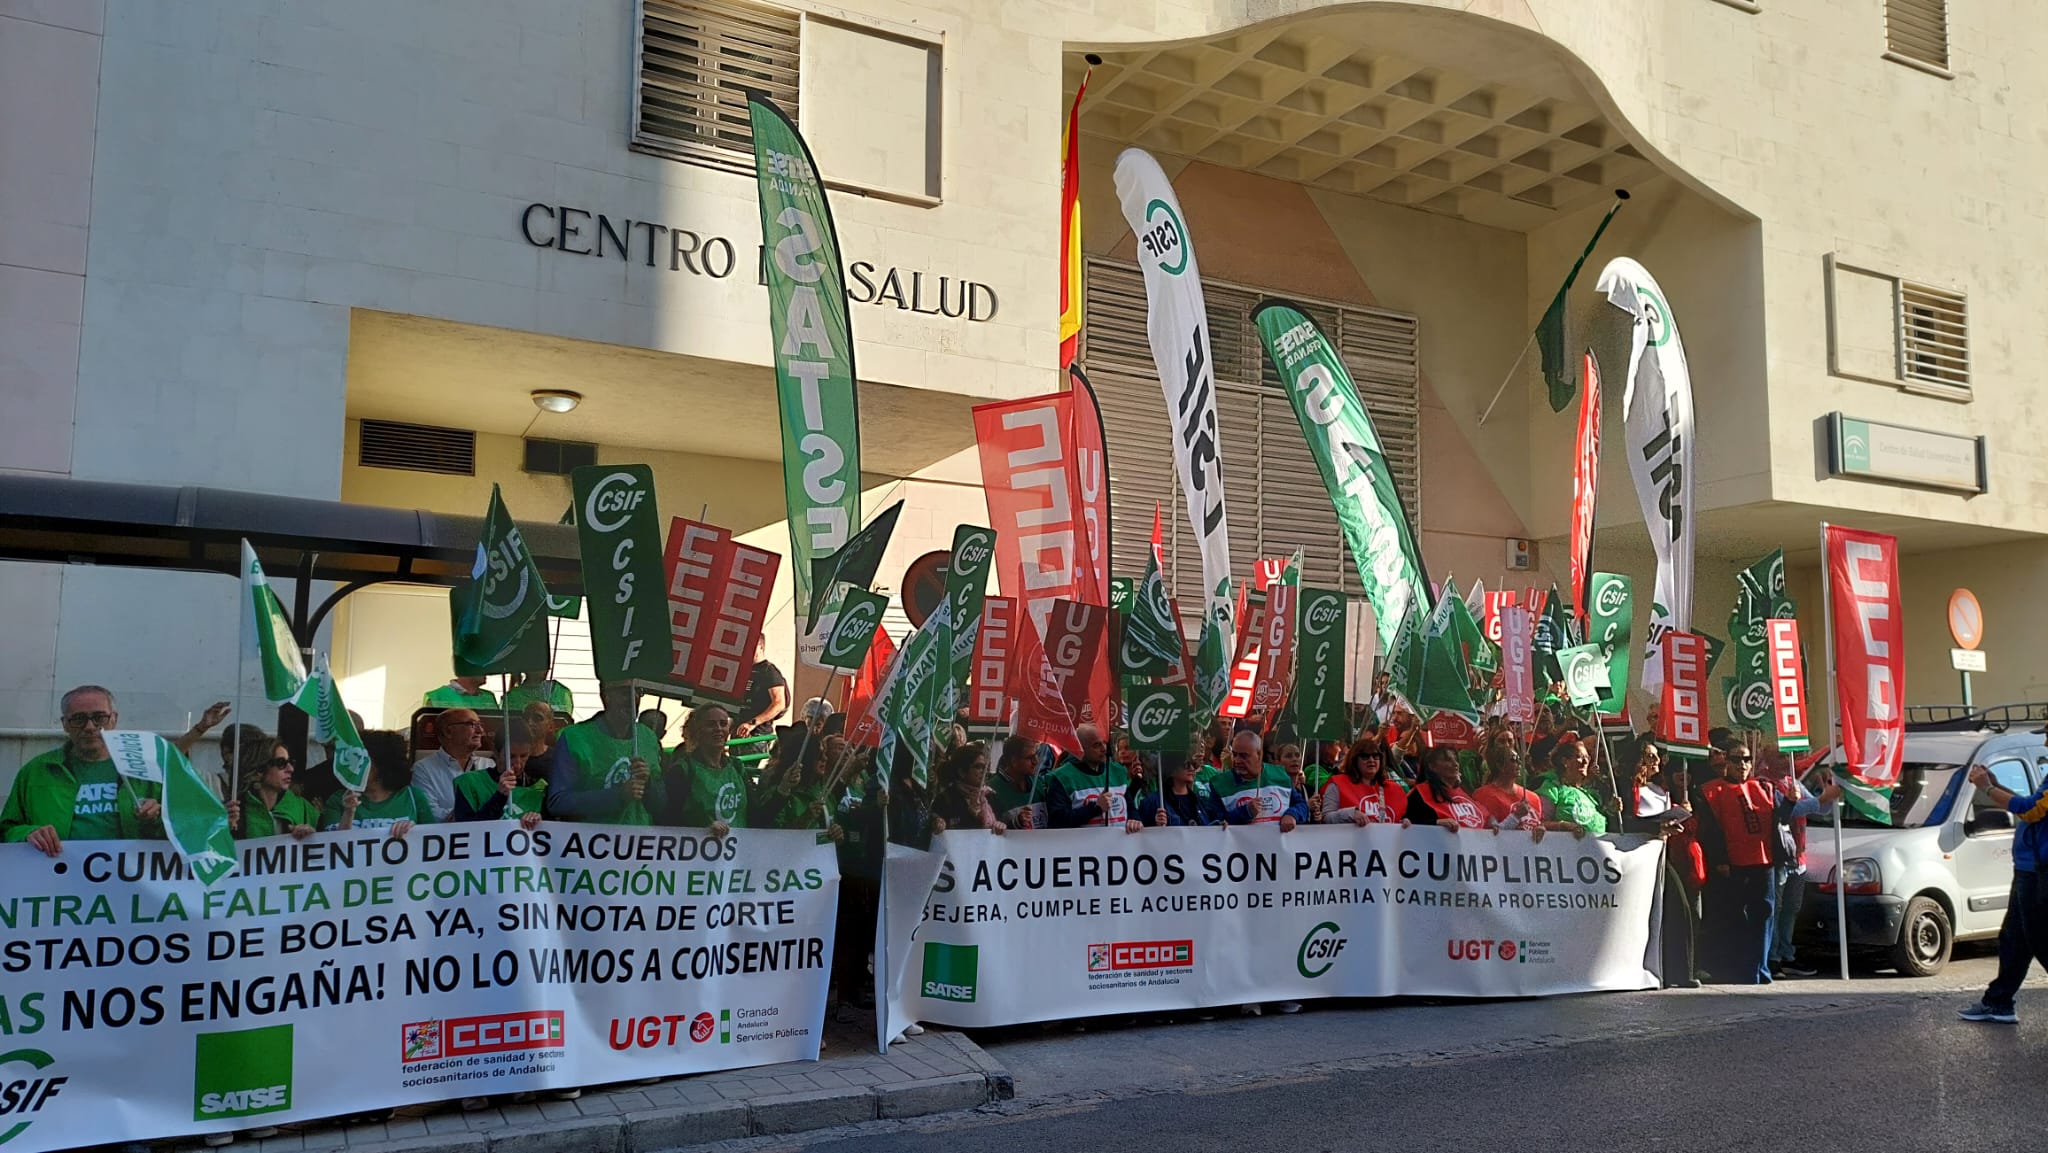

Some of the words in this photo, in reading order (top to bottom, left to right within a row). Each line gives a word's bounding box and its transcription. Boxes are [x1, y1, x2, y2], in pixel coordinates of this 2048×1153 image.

[522, 203, 736, 279] CENTRO
[846, 261, 999, 323] SALUD
[612, 537, 645, 672] CSIF
[699, 545, 769, 693] CCOO
[1268, 586, 1288, 679] UGT
[1510, 609, 1525, 694] UGT
[978, 599, 1009, 717] CCOO
[1773, 623, 1802, 732] CCOO
[1311, 640, 1328, 734] CSIF
[1672, 636, 1700, 741] CCOO
[83, 837, 408, 884] CUMIMIENTO
[422, 832, 470, 863] DE
[484, 829, 552, 859] LOS
[560, 830, 738, 863] ACUERDOS
[971, 853, 1186, 893] ACUERDOS
[1202, 852, 1278, 884] SON
[1295, 849, 1387, 881] PARA
[1398, 849, 1622, 885] CUMPLIRLOS
[131, 889, 189, 924] LA
[203, 882, 331, 921] FALTA
[343, 876, 394, 908] DE
[407, 865, 676, 902] CONTRATACIÓN
[687, 869, 725, 896] EN
[728, 868, 757, 894] EL
[764, 868, 824, 892] SAS
[1016, 897, 1101, 919] CUMPLE
[1110, 897, 1133, 914] EL
[1142, 892, 1239, 914] ACUERDO
[1246, 891, 1273, 909] DE
[1282, 887, 1375, 909] PRIMARIA
[1382, 887, 1391, 903] Y
[1395, 887, 1493, 909] CARRERA
[1499, 892, 1618, 909] PROFESIONAL
[3, 932, 191, 973] STADOS
[207, 926, 265, 962] DE
[280, 912, 417, 956] BOLSA
[426, 906, 486, 940] YA,
[497, 902, 550, 932] SIN
[556, 904, 647, 933] NOTA
[655, 903, 697, 931] DE
[705, 899, 795, 929] CORTE
[1115, 945, 1174, 965] CCOO
[1447, 939, 1495, 961] UGT
[62, 984, 165, 1032] NOS
[180, 959, 385, 1023] ENGAÑA!
[405, 954, 461, 996] NO
[472, 949, 519, 990] LO
[528, 947, 634, 985] VAMOS
[641, 947, 662, 983] A
[671, 936, 824, 981] CONSENTIR
[925, 980, 973, 1000] SATSE
[1088, 971, 1122, 981] federación
[1123, 970, 1132, 978] de
[1133, 968, 1159, 977] sanidad
[1165, 967, 1193, 975] sectores
[1088, 980, 1138, 991] sociosanitarios
[1139, 979, 1147, 987] de
[452, 1017, 549, 1048] CCOO
[609, 1013, 687, 1052] UGT
[736, 1006, 779, 1019] Granada
[736, 1032, 774, 1044] Servicios
[775, 1027, 809, 1040] Públicos
[402, 1055, 463, 1074] federación
[466, 1055, 481, 1067] de
[483, 1052, 526, 1066] sanidad
[529, 1053, 536, 1064] y
[402, 1069, 490, 1089] sociosanitarios
[492, 1067, 506, 1078] de
[200, 1084, 287, 1115] SATSE
